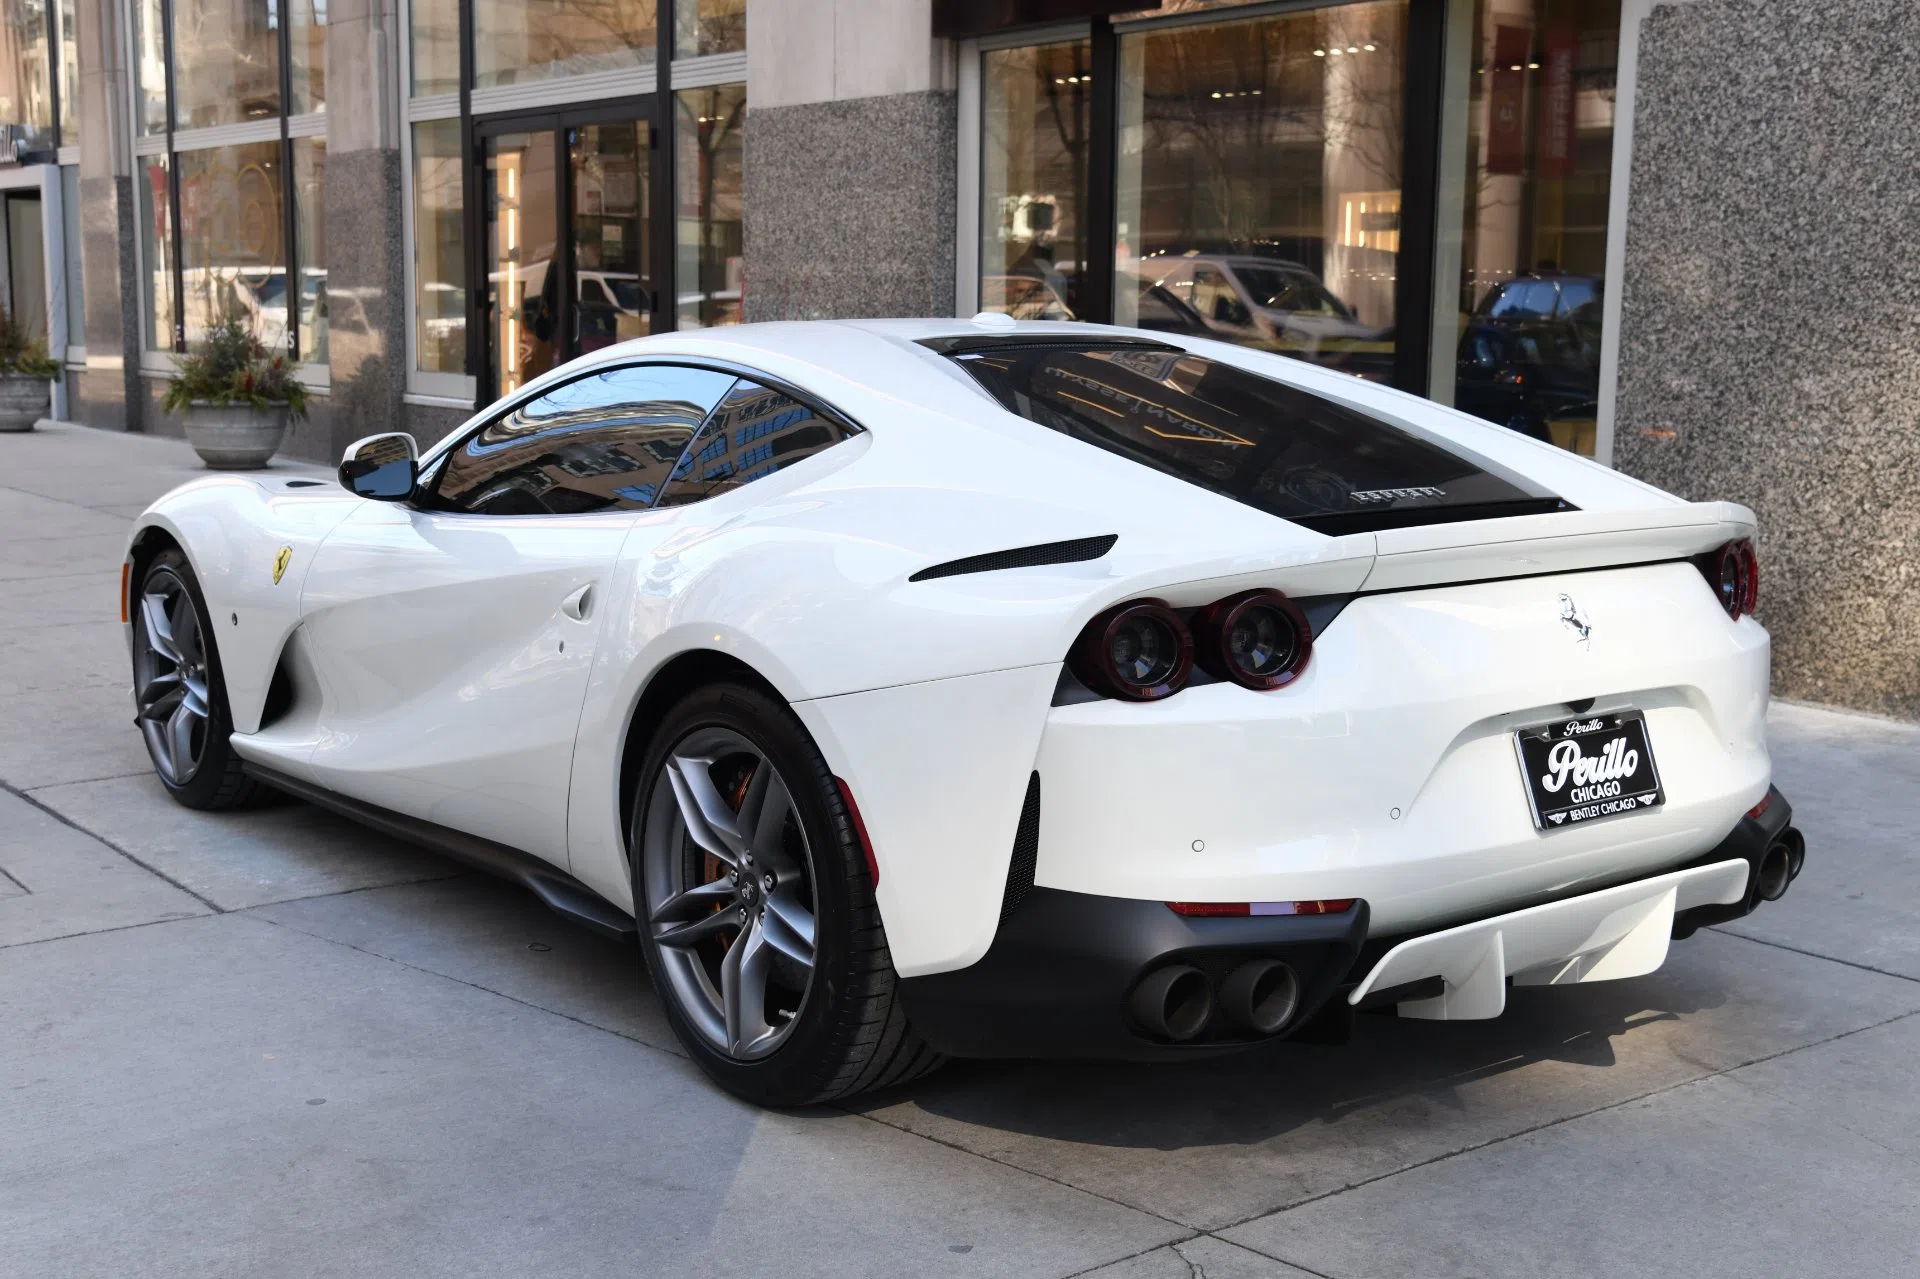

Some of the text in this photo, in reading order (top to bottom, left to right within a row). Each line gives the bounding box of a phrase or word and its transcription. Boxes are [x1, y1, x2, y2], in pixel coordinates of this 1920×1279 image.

[1563, 718, 1603, 736] Perillo
[1542, 737, 1638, 792] Perillo
[1571, 781, 1620, 803] CHICAGO
[1570, 798, 1636, 821] BENTLEY CHICAGO
